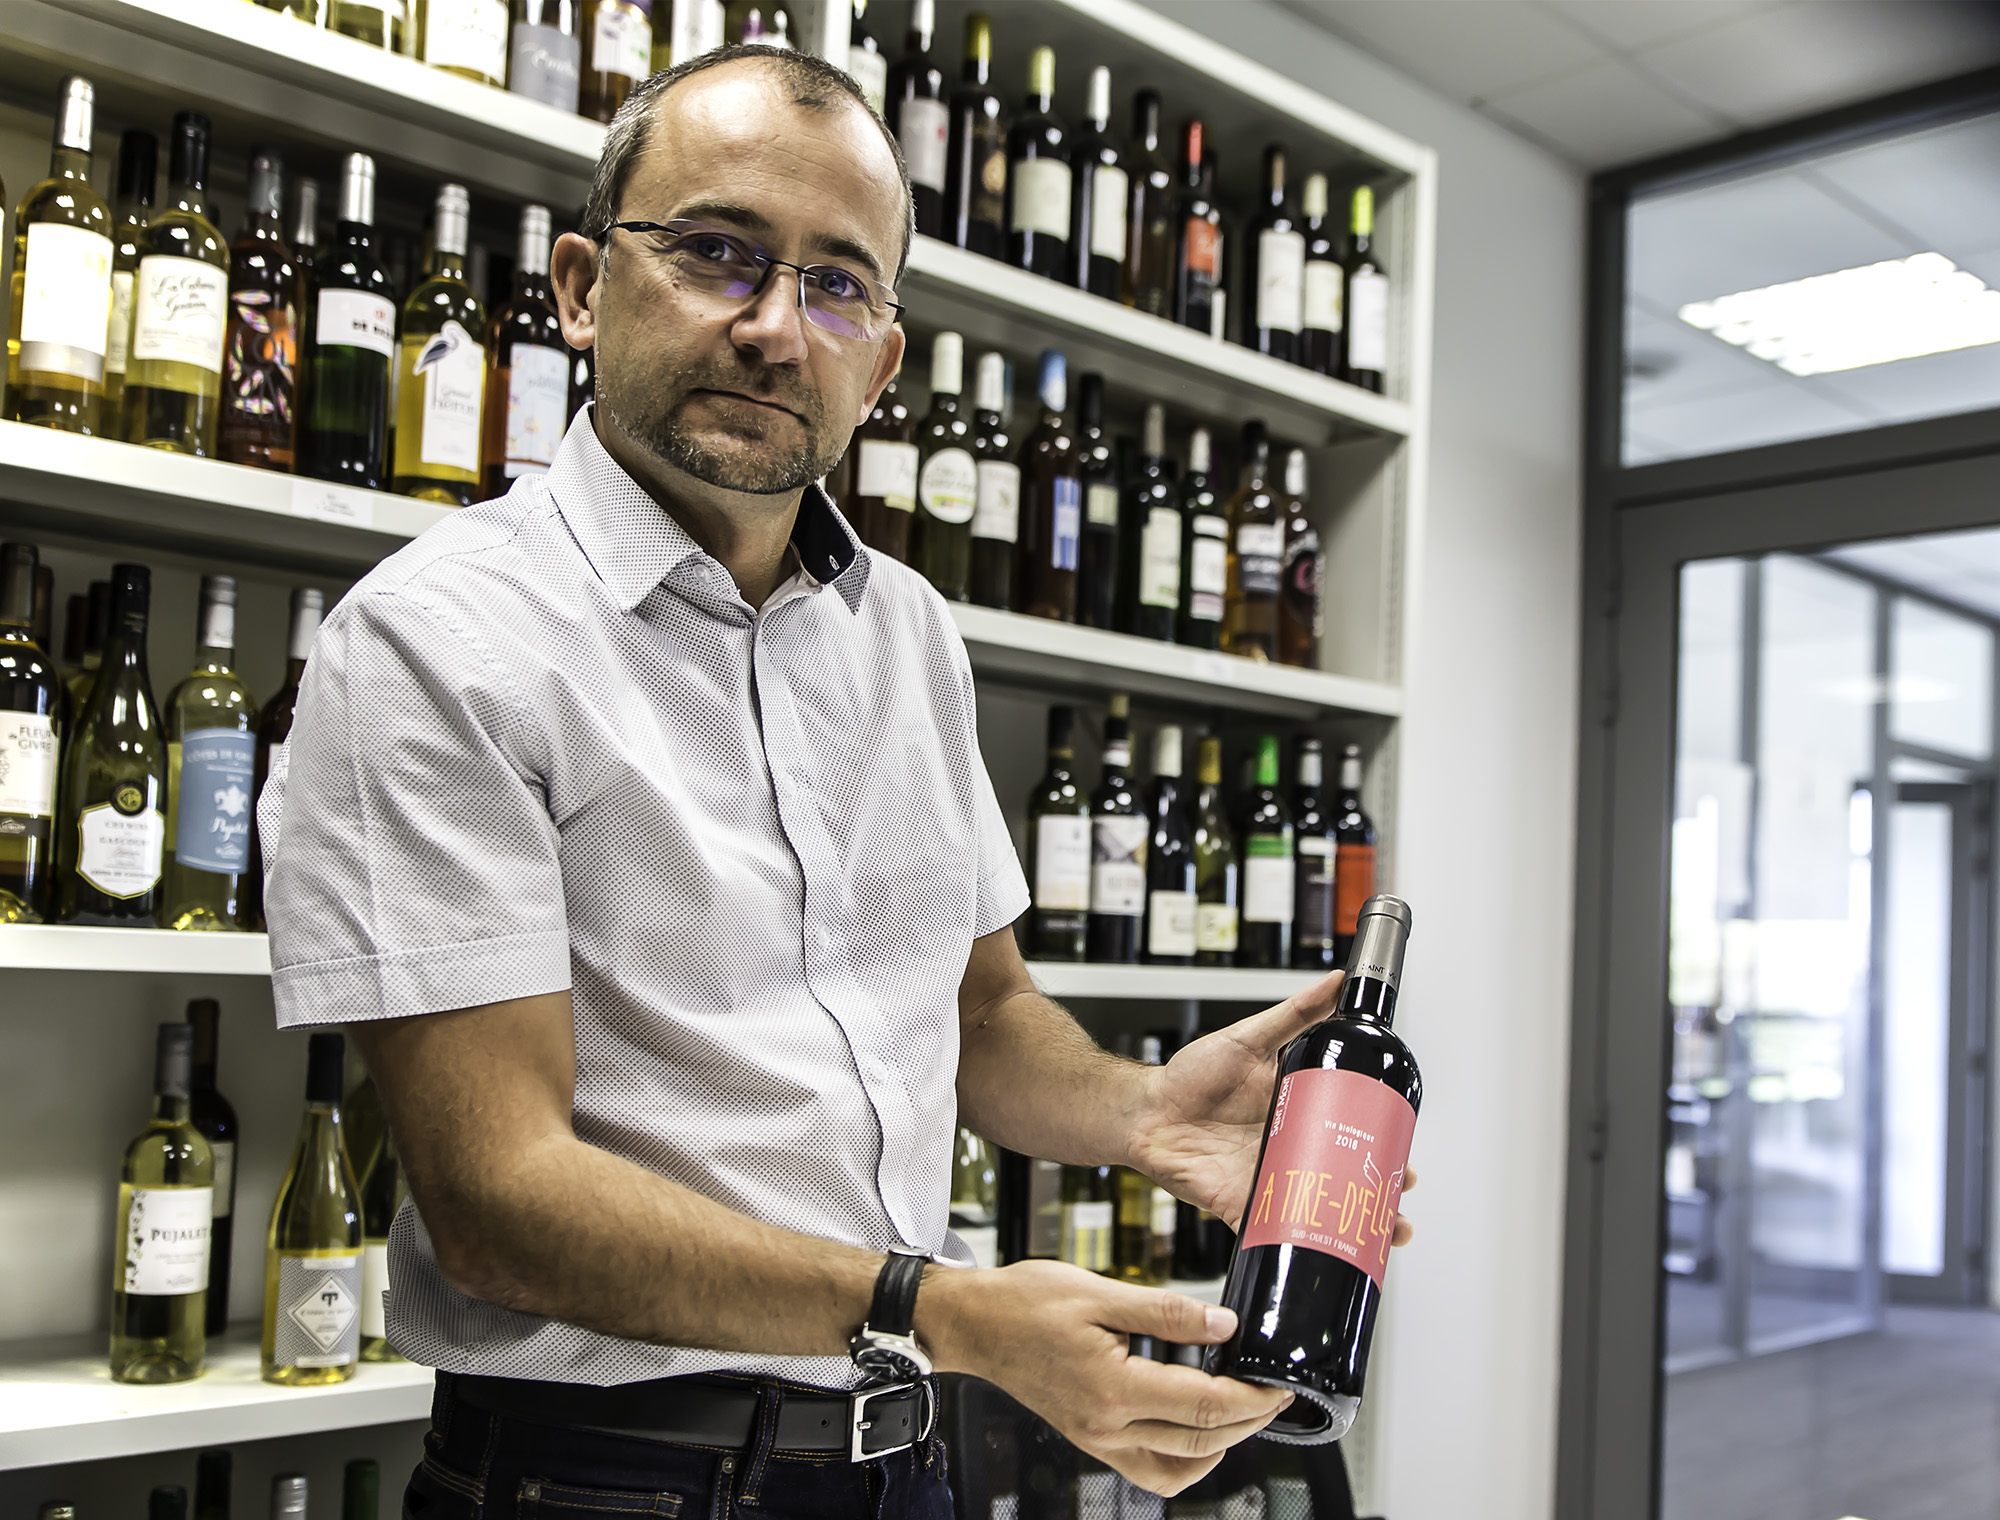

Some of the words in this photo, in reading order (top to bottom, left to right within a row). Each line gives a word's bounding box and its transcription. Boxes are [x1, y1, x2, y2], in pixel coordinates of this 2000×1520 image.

[1270, 1108, 1284, 1138] SAINT
[1277, 1076, 1291, 1108] MONT
[1324, 1119, 1337, 1130] Vin
[1338, 1121, 1375, 1143] biologique
[1335, 1134, 1358, 1151] 2018
[1253, 1171, 1275, 1227] A
